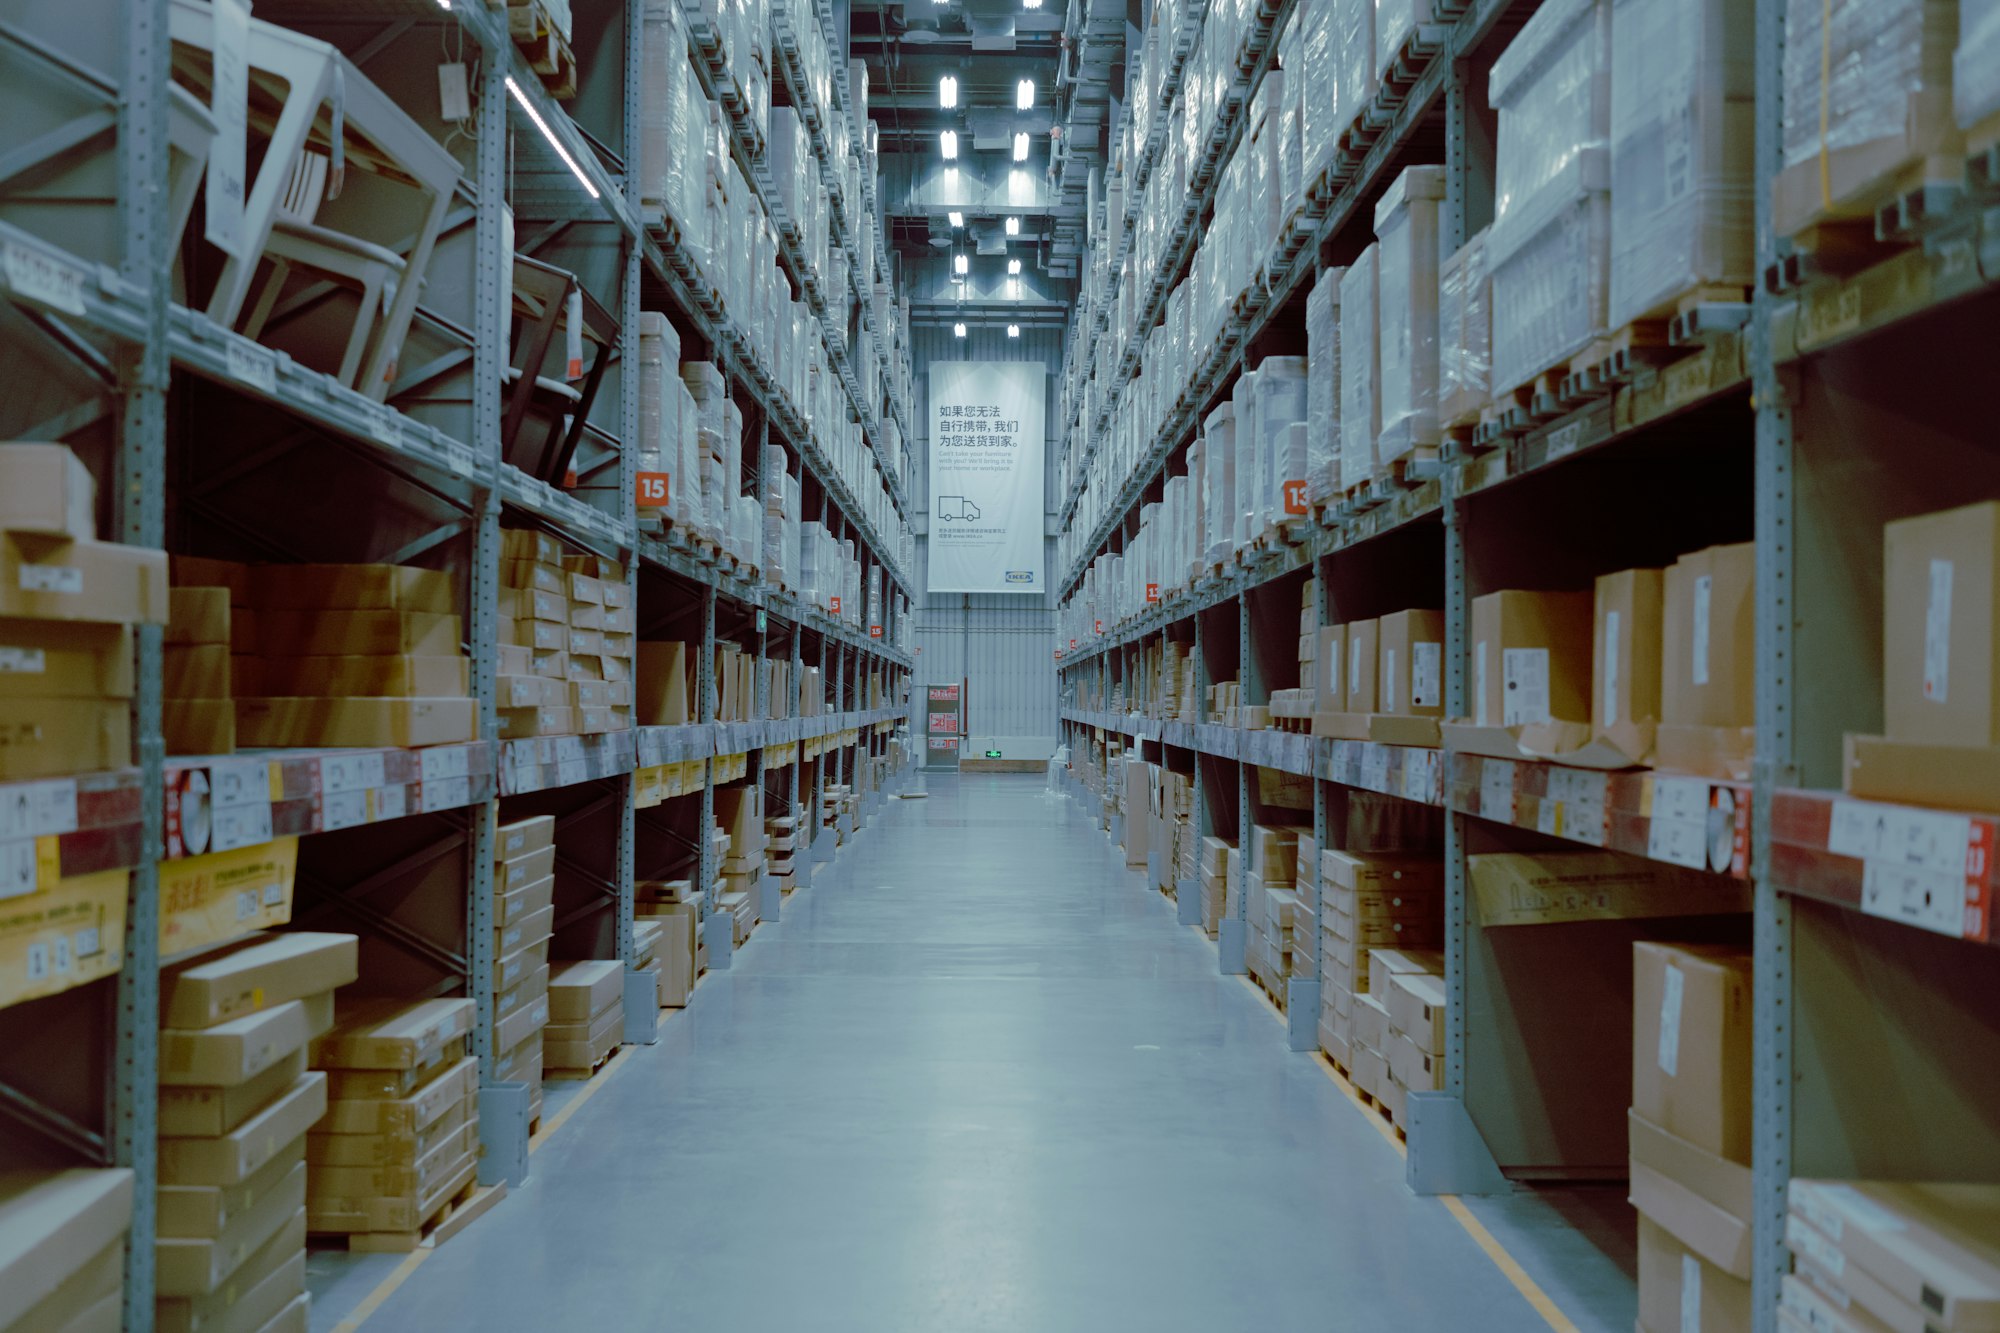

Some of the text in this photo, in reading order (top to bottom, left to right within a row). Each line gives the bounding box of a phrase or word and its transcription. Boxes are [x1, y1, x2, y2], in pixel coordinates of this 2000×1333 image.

[939, 405, 1001, 418] 如果您无法
[939, 435, 1018, 448] 为您送货到家。
[642, 479, 665, 499] 15
